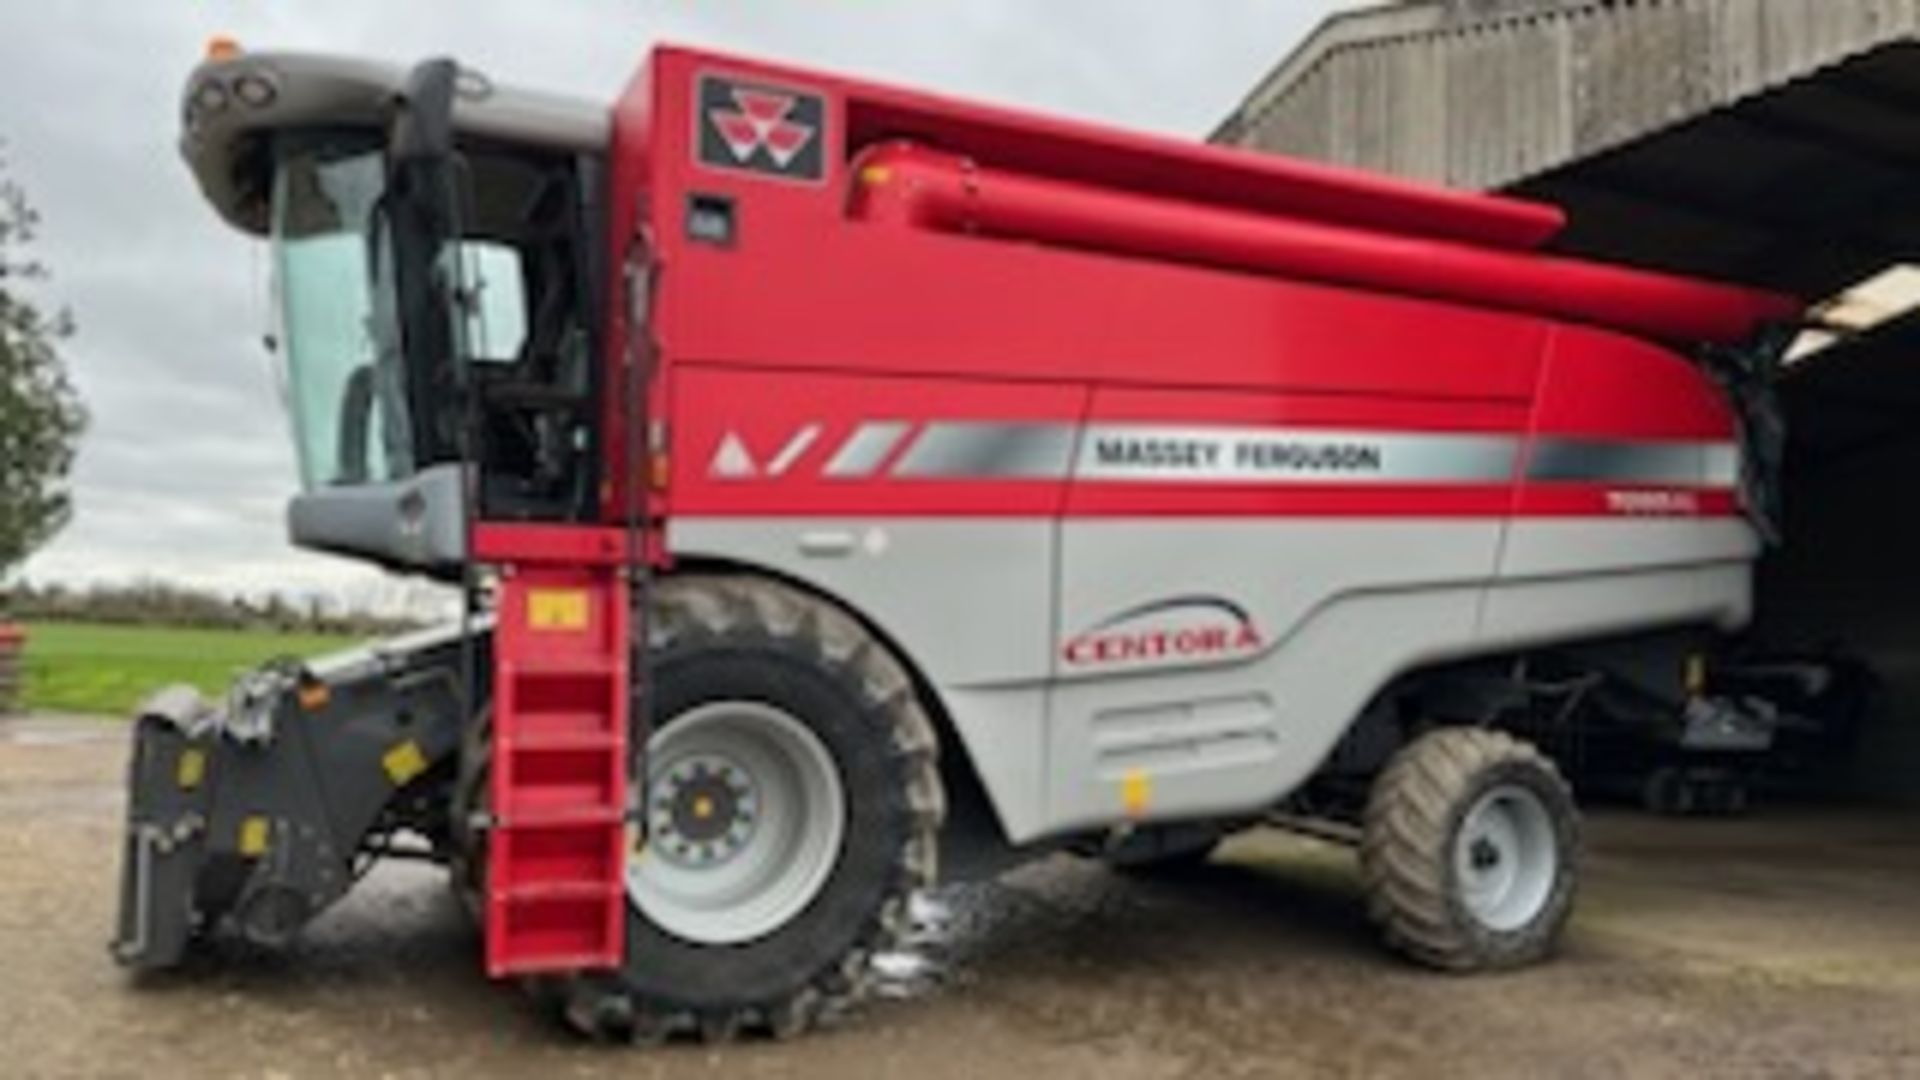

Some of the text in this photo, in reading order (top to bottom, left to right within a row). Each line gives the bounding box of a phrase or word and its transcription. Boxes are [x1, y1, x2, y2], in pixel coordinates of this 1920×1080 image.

[1096, 438, 1382, 472] MASSEY FERGUSON
[1063, 622, 1262, 664] CENTORA
